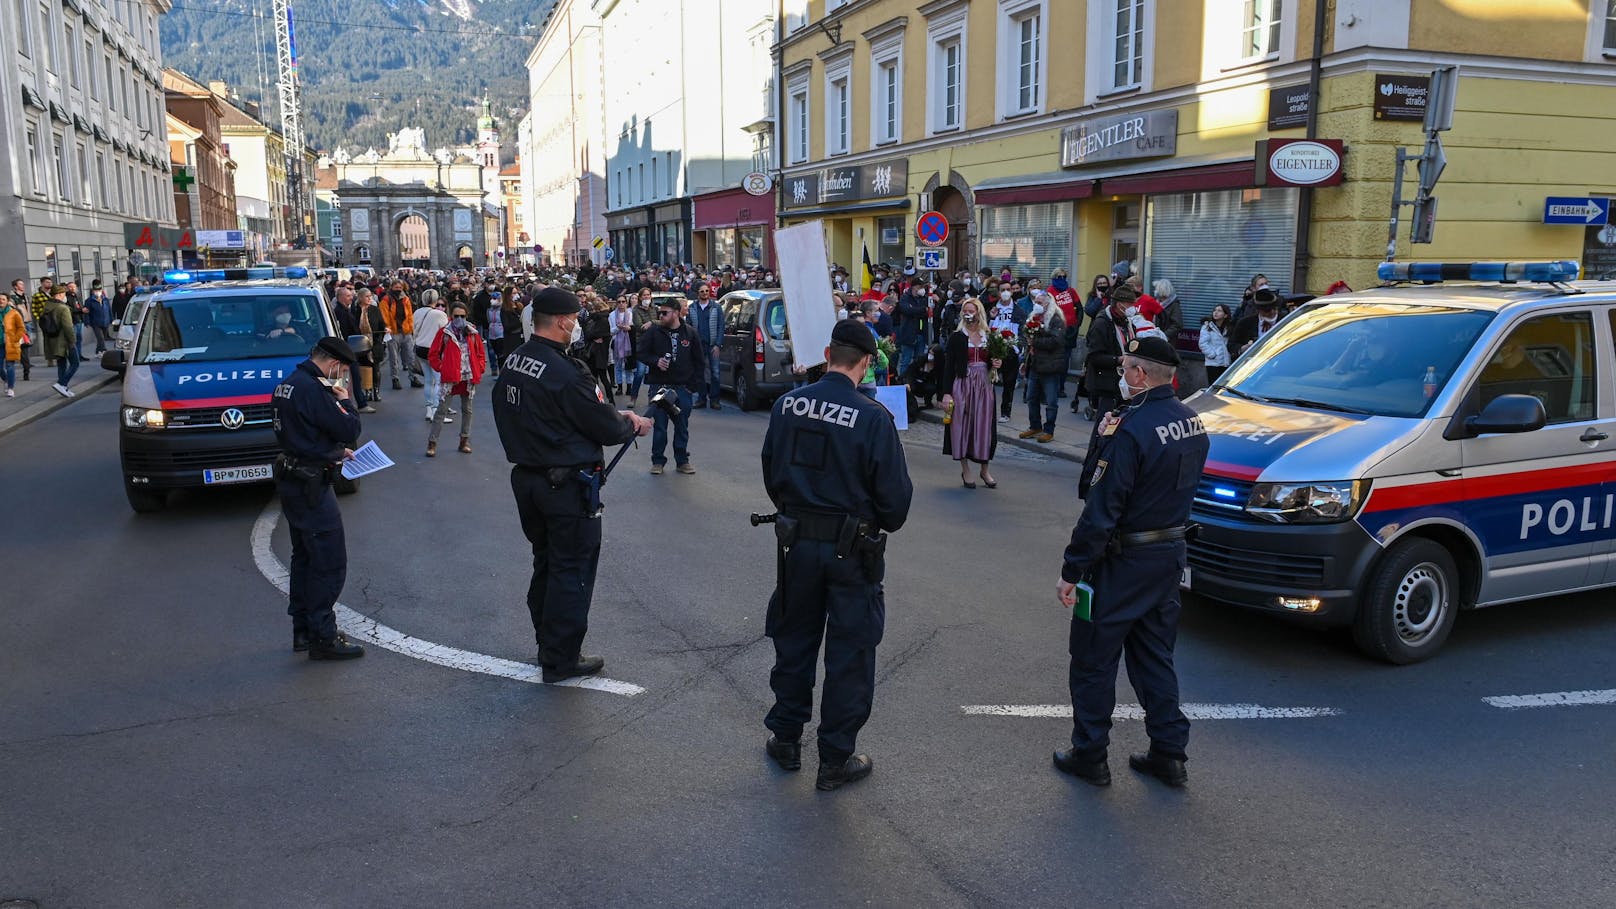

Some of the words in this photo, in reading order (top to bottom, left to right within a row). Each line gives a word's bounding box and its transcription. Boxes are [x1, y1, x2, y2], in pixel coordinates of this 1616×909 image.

[1289, 102, 1308, 113] straße
[1405, 97, 1426, 106] straße
[1068, 117, 1145, 163] EIGENTLER
[1276, 159, 1333, 170] EIGENTLER
[1552, 206, 1586, 215] EINBAHN
[178, 370, 283, 385] POLIZEI
[781, 396, 860, 428] POLIZEI
[213, 469, 229, 481] BP
[234, 467, 268, 479] 70659
[1519, 494, 1614, 540] POLI
